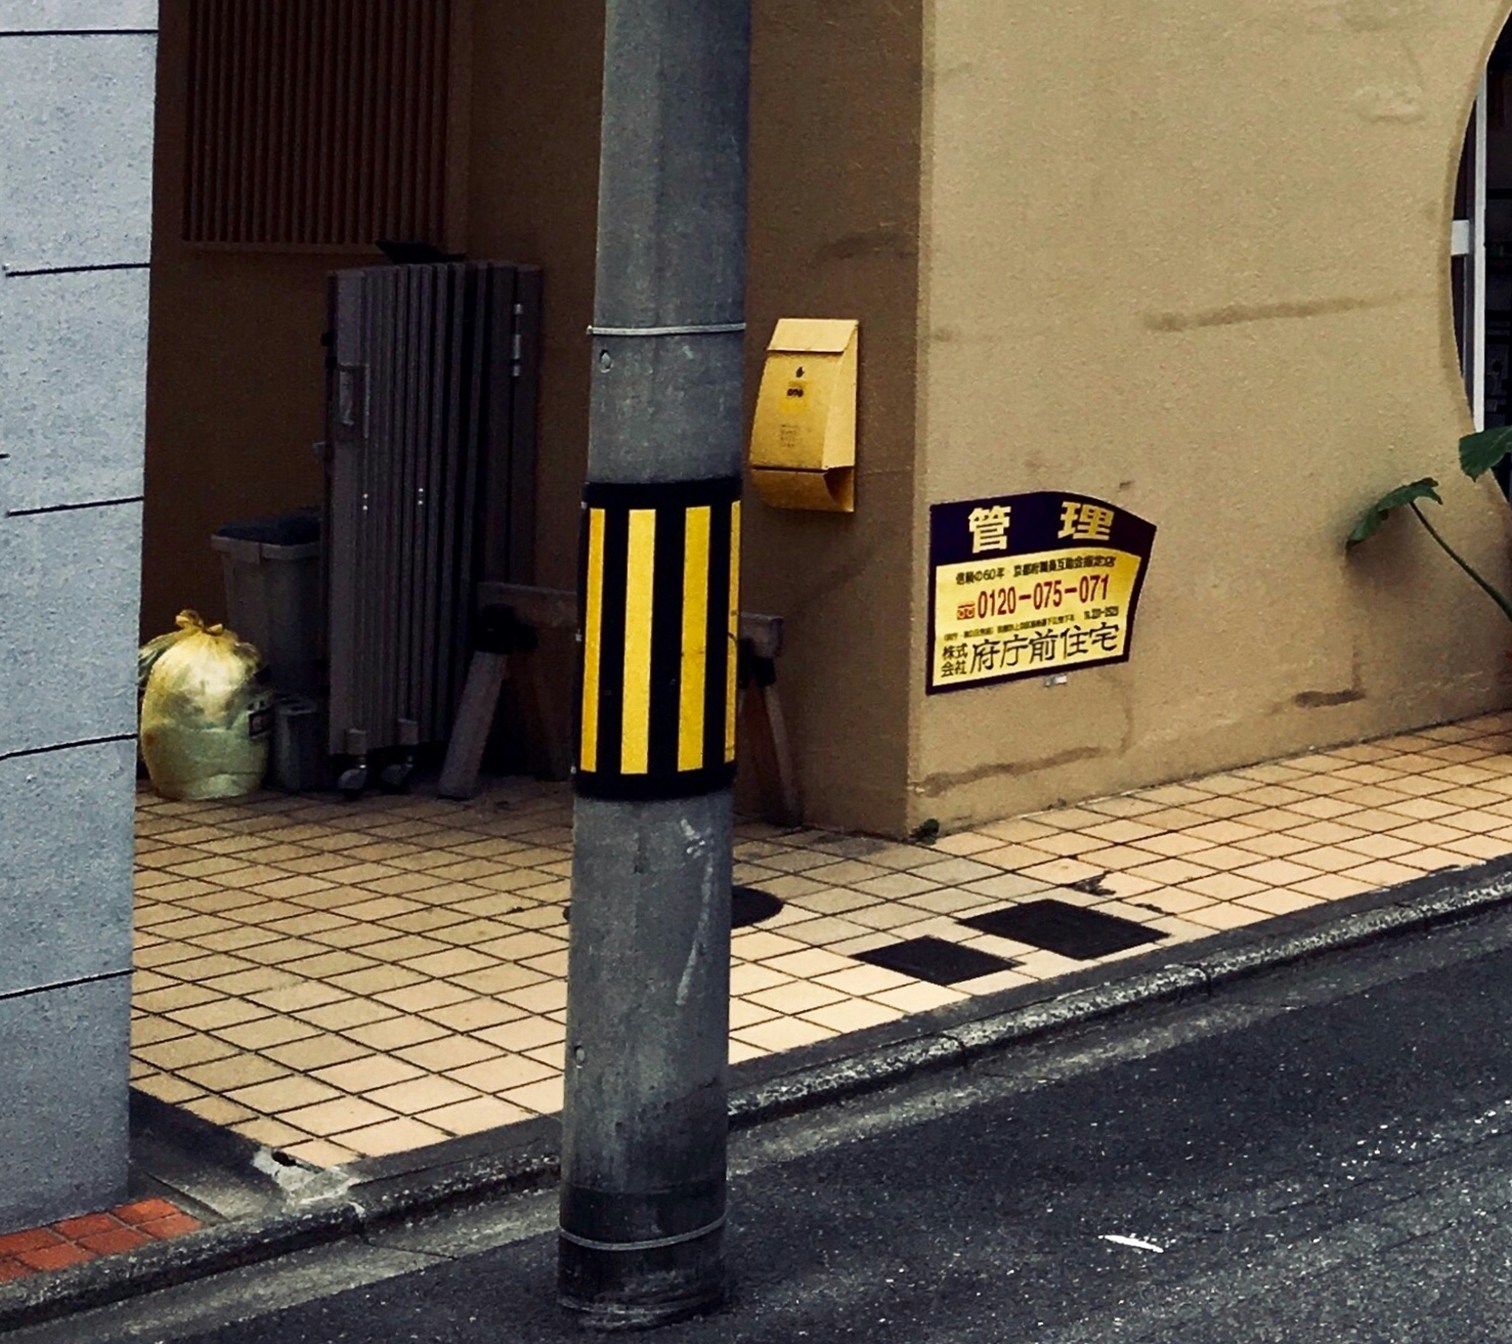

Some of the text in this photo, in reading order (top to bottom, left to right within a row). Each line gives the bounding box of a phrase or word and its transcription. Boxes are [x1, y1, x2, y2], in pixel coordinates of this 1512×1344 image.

[968, 501, 1115, 553] 管理
[977, 574, 1110, 620] 0120-075-071
[969, 621, 1120, 674] 府庁前住宅
